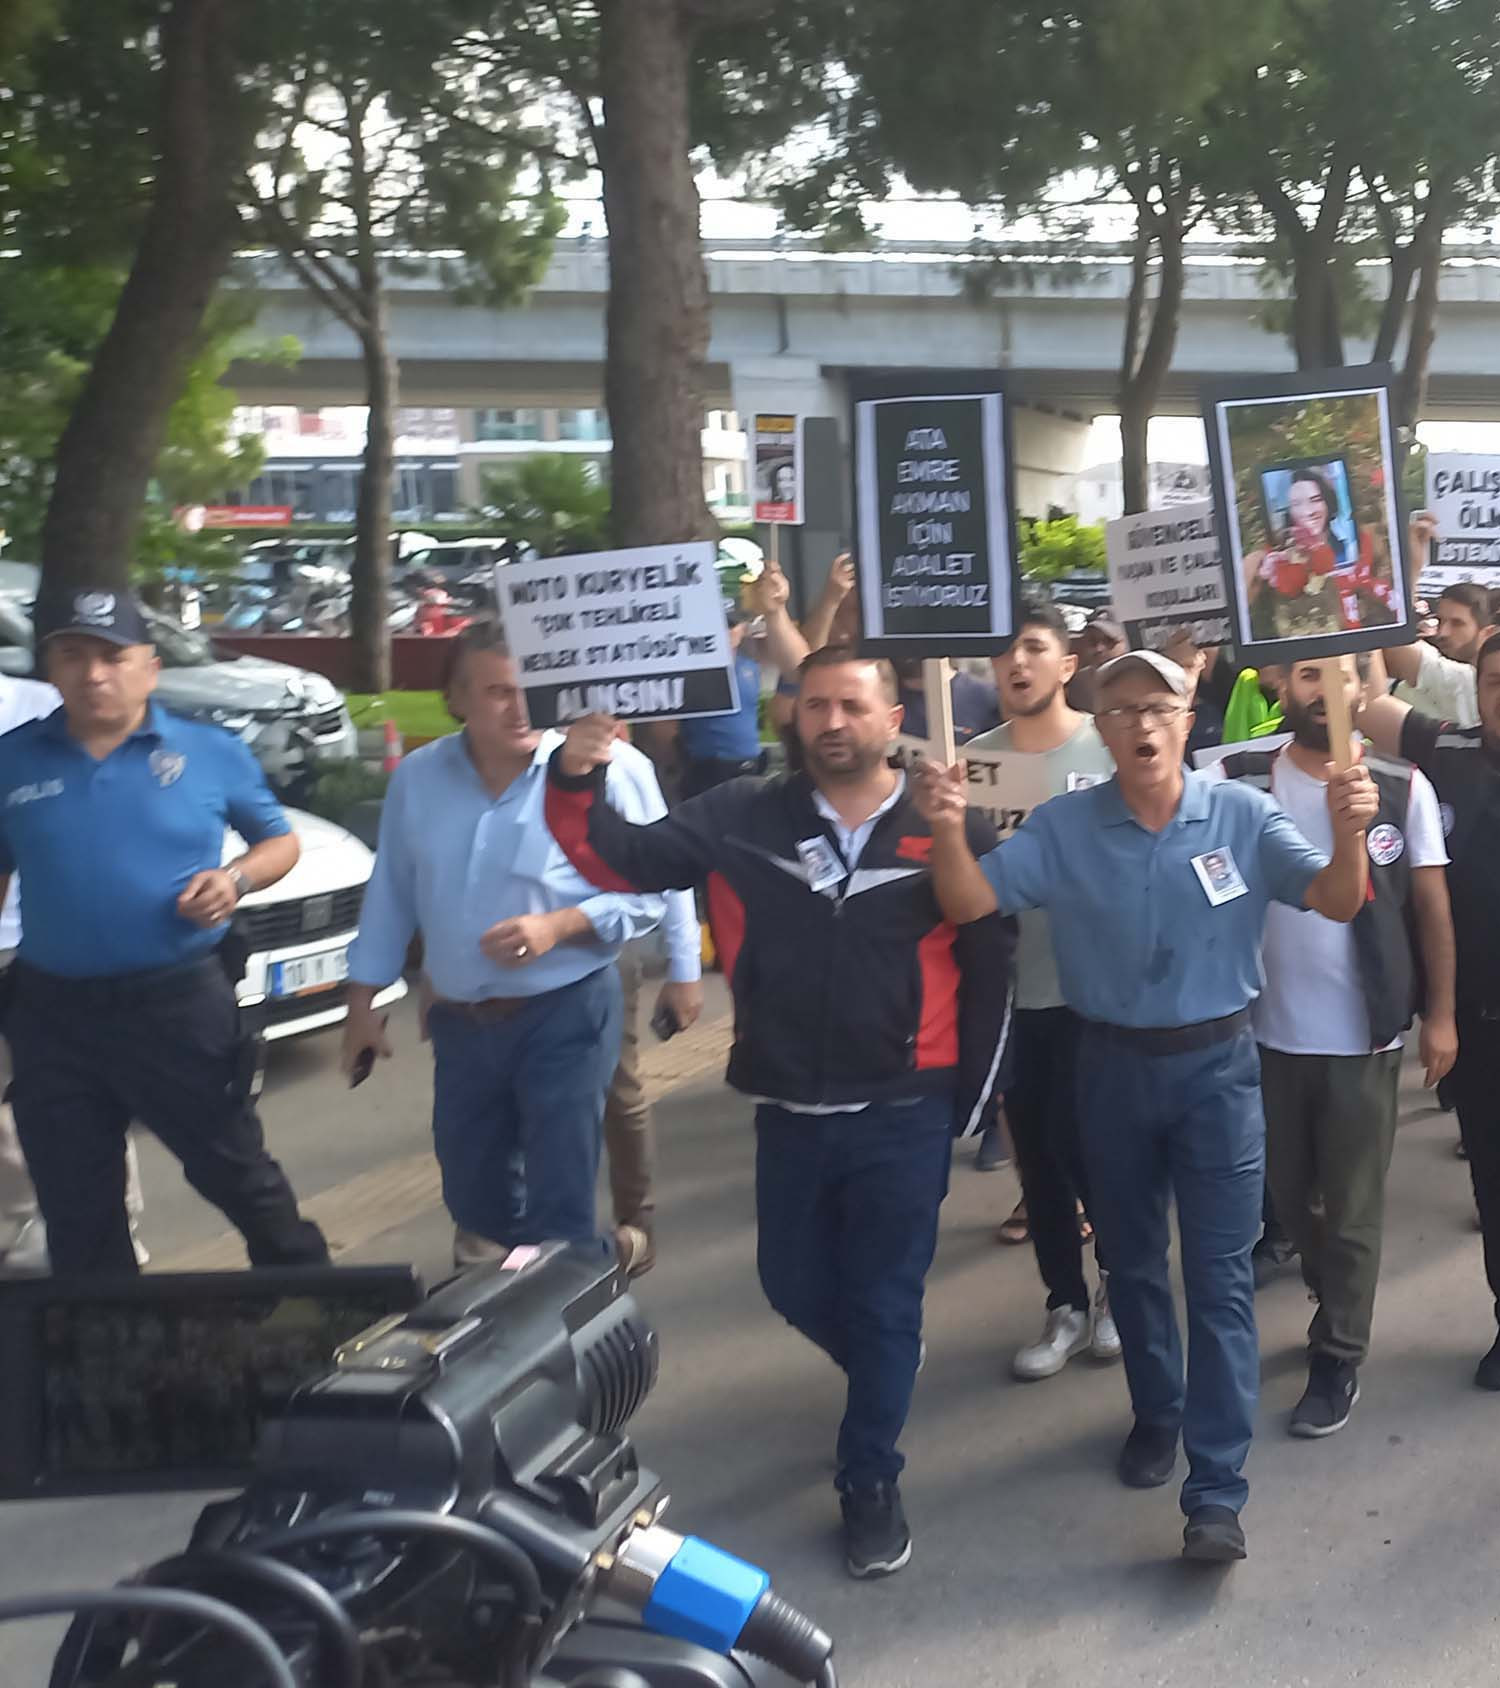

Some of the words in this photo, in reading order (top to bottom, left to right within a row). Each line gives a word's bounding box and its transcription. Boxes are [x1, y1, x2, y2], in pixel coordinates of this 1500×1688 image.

[905, 427, 948, 450] ATA
[897, 459, 960, 483] EMRE
[891, 553, 976, 577] ADALET
[509, 575, 568, 605] MOTO
[575, 556, 703, 598] KURYELİK
